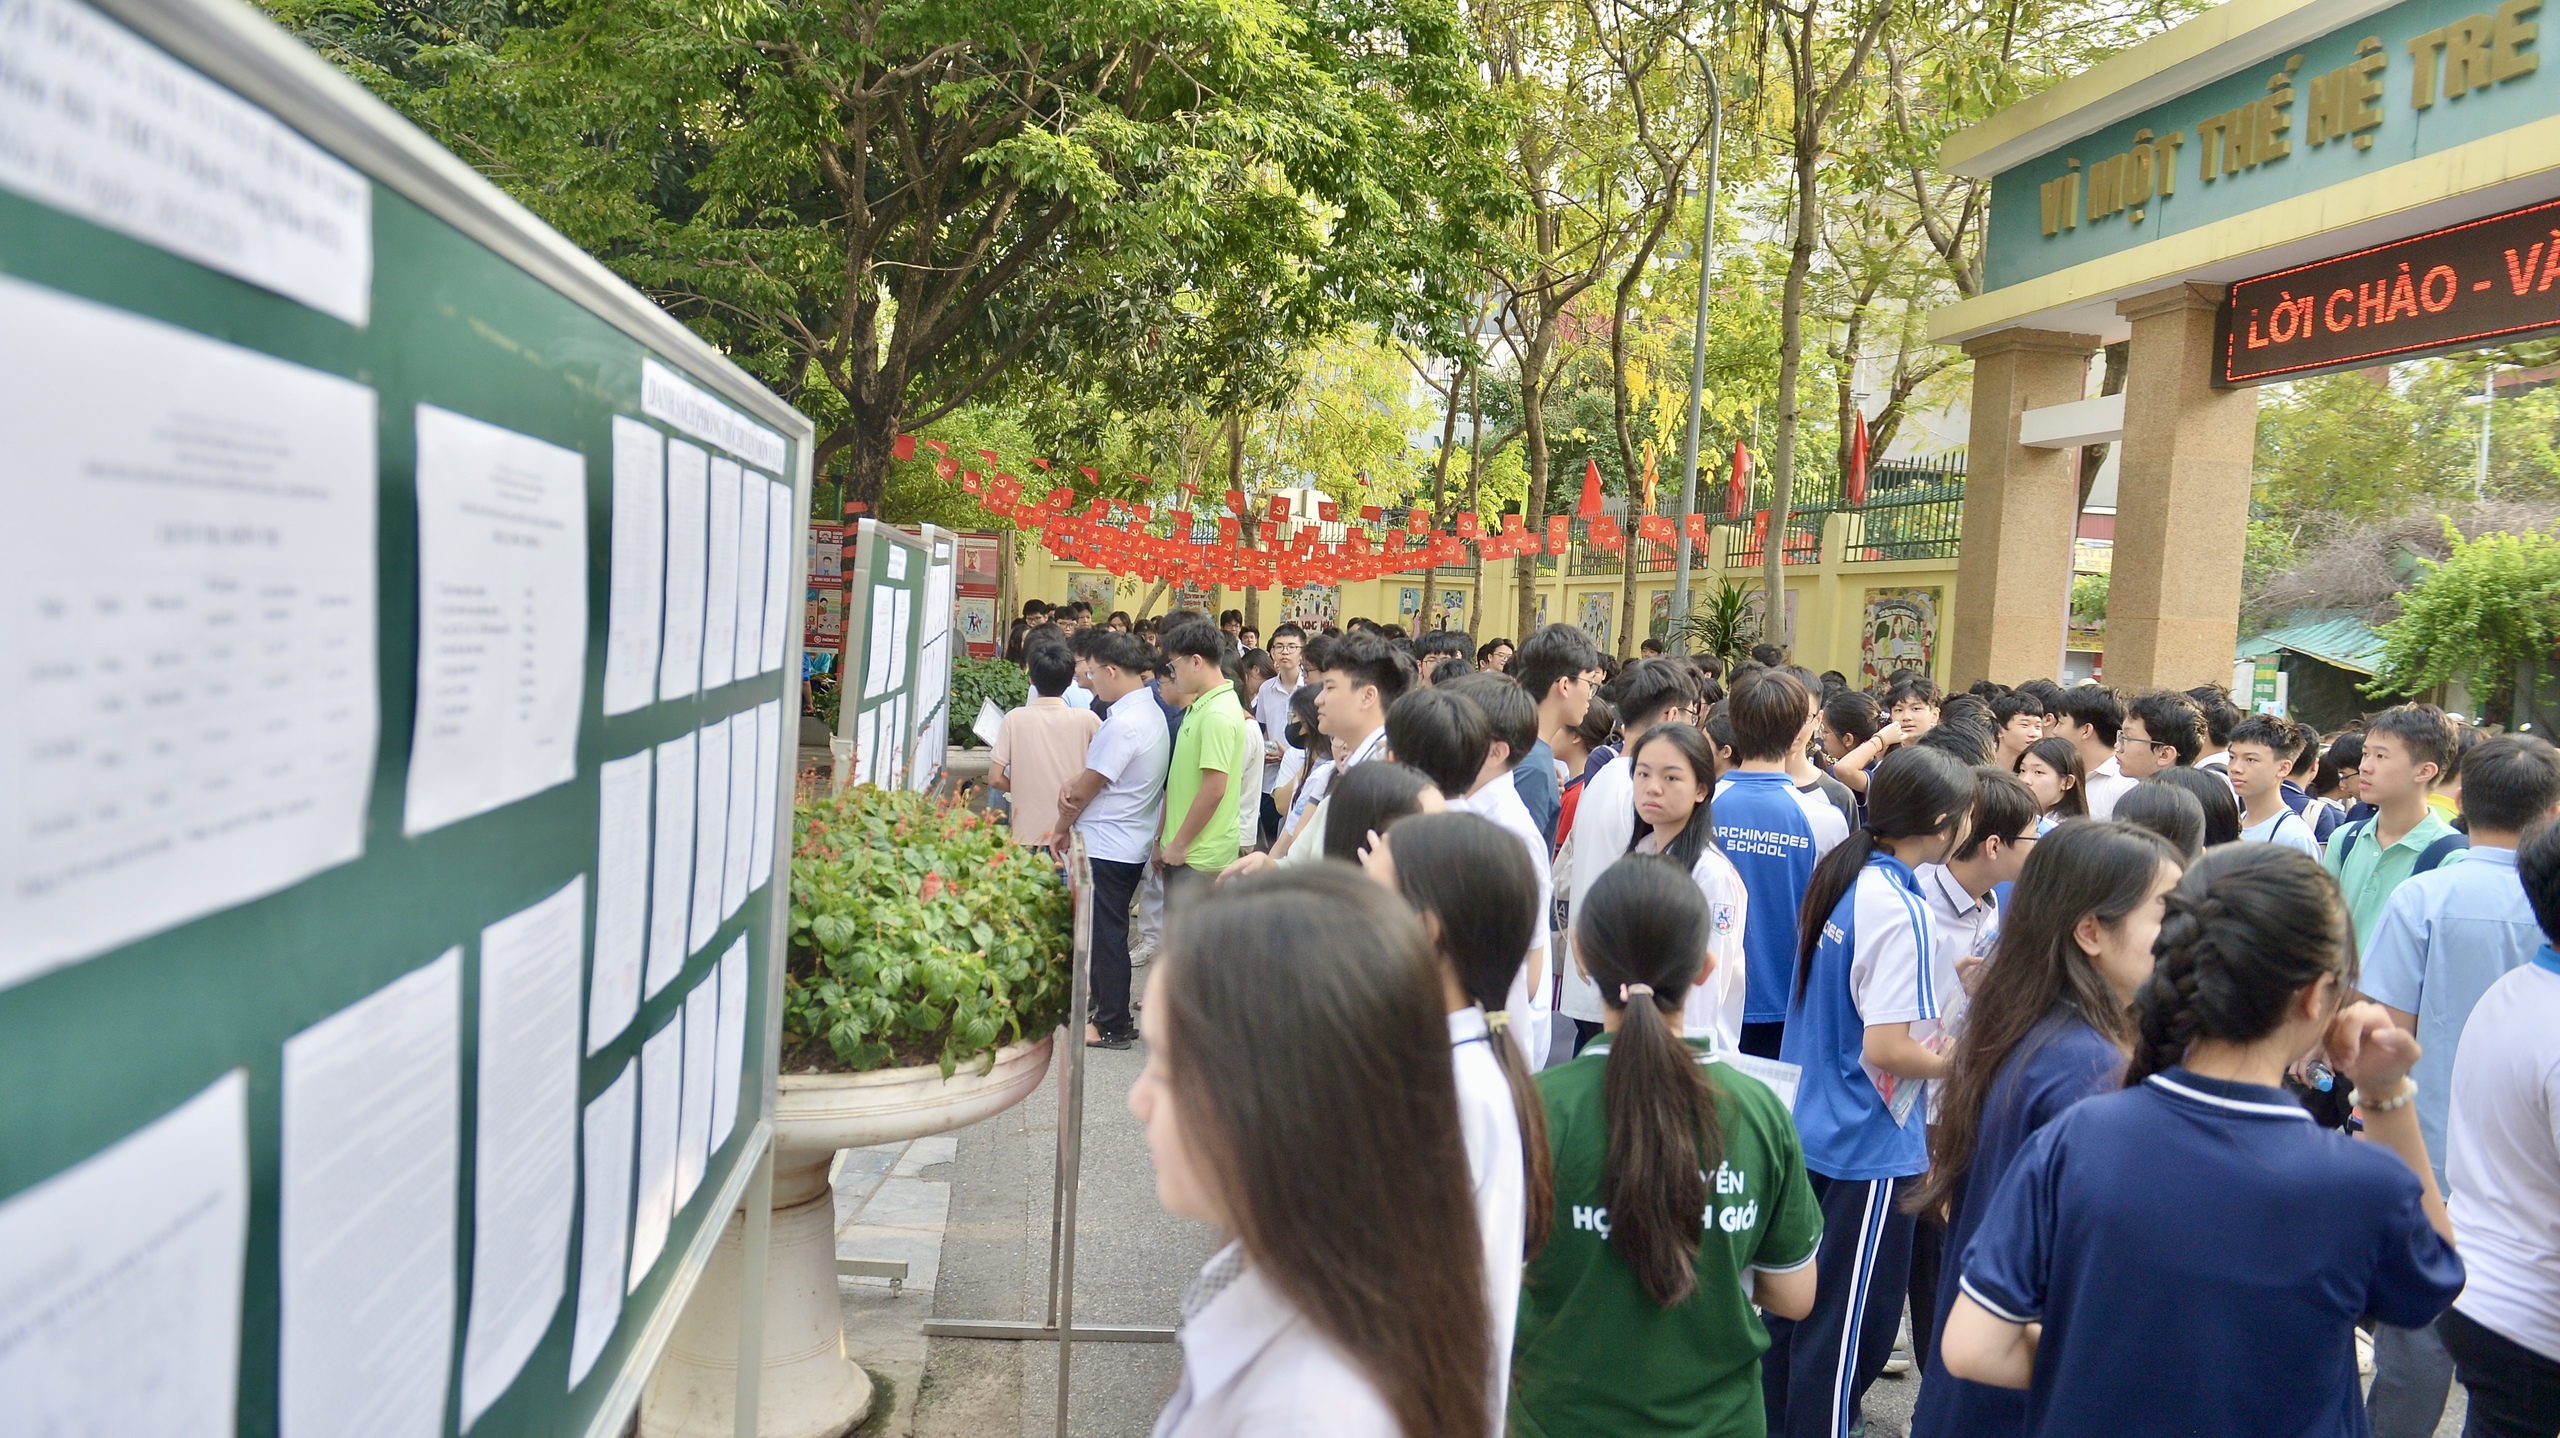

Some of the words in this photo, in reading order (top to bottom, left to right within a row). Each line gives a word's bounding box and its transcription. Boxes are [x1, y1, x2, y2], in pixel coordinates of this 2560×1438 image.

[2040, 157, 2081, 237] VÌ
[2086, 128, 2185, 223] MỘT
[2197, 54, 2304, 182] THẾ
[2306, 35, 2388, 151] HỆ
[2247, 290, 2315, 350] LỜI
[2324, 261, 2458, 333] CHÀO
[1726, 839, 1787, 858] SCHOOL
[1698, 1160, 1744, 1195] YỂN
[1572, 1205, 1612, 1240] HỌ
